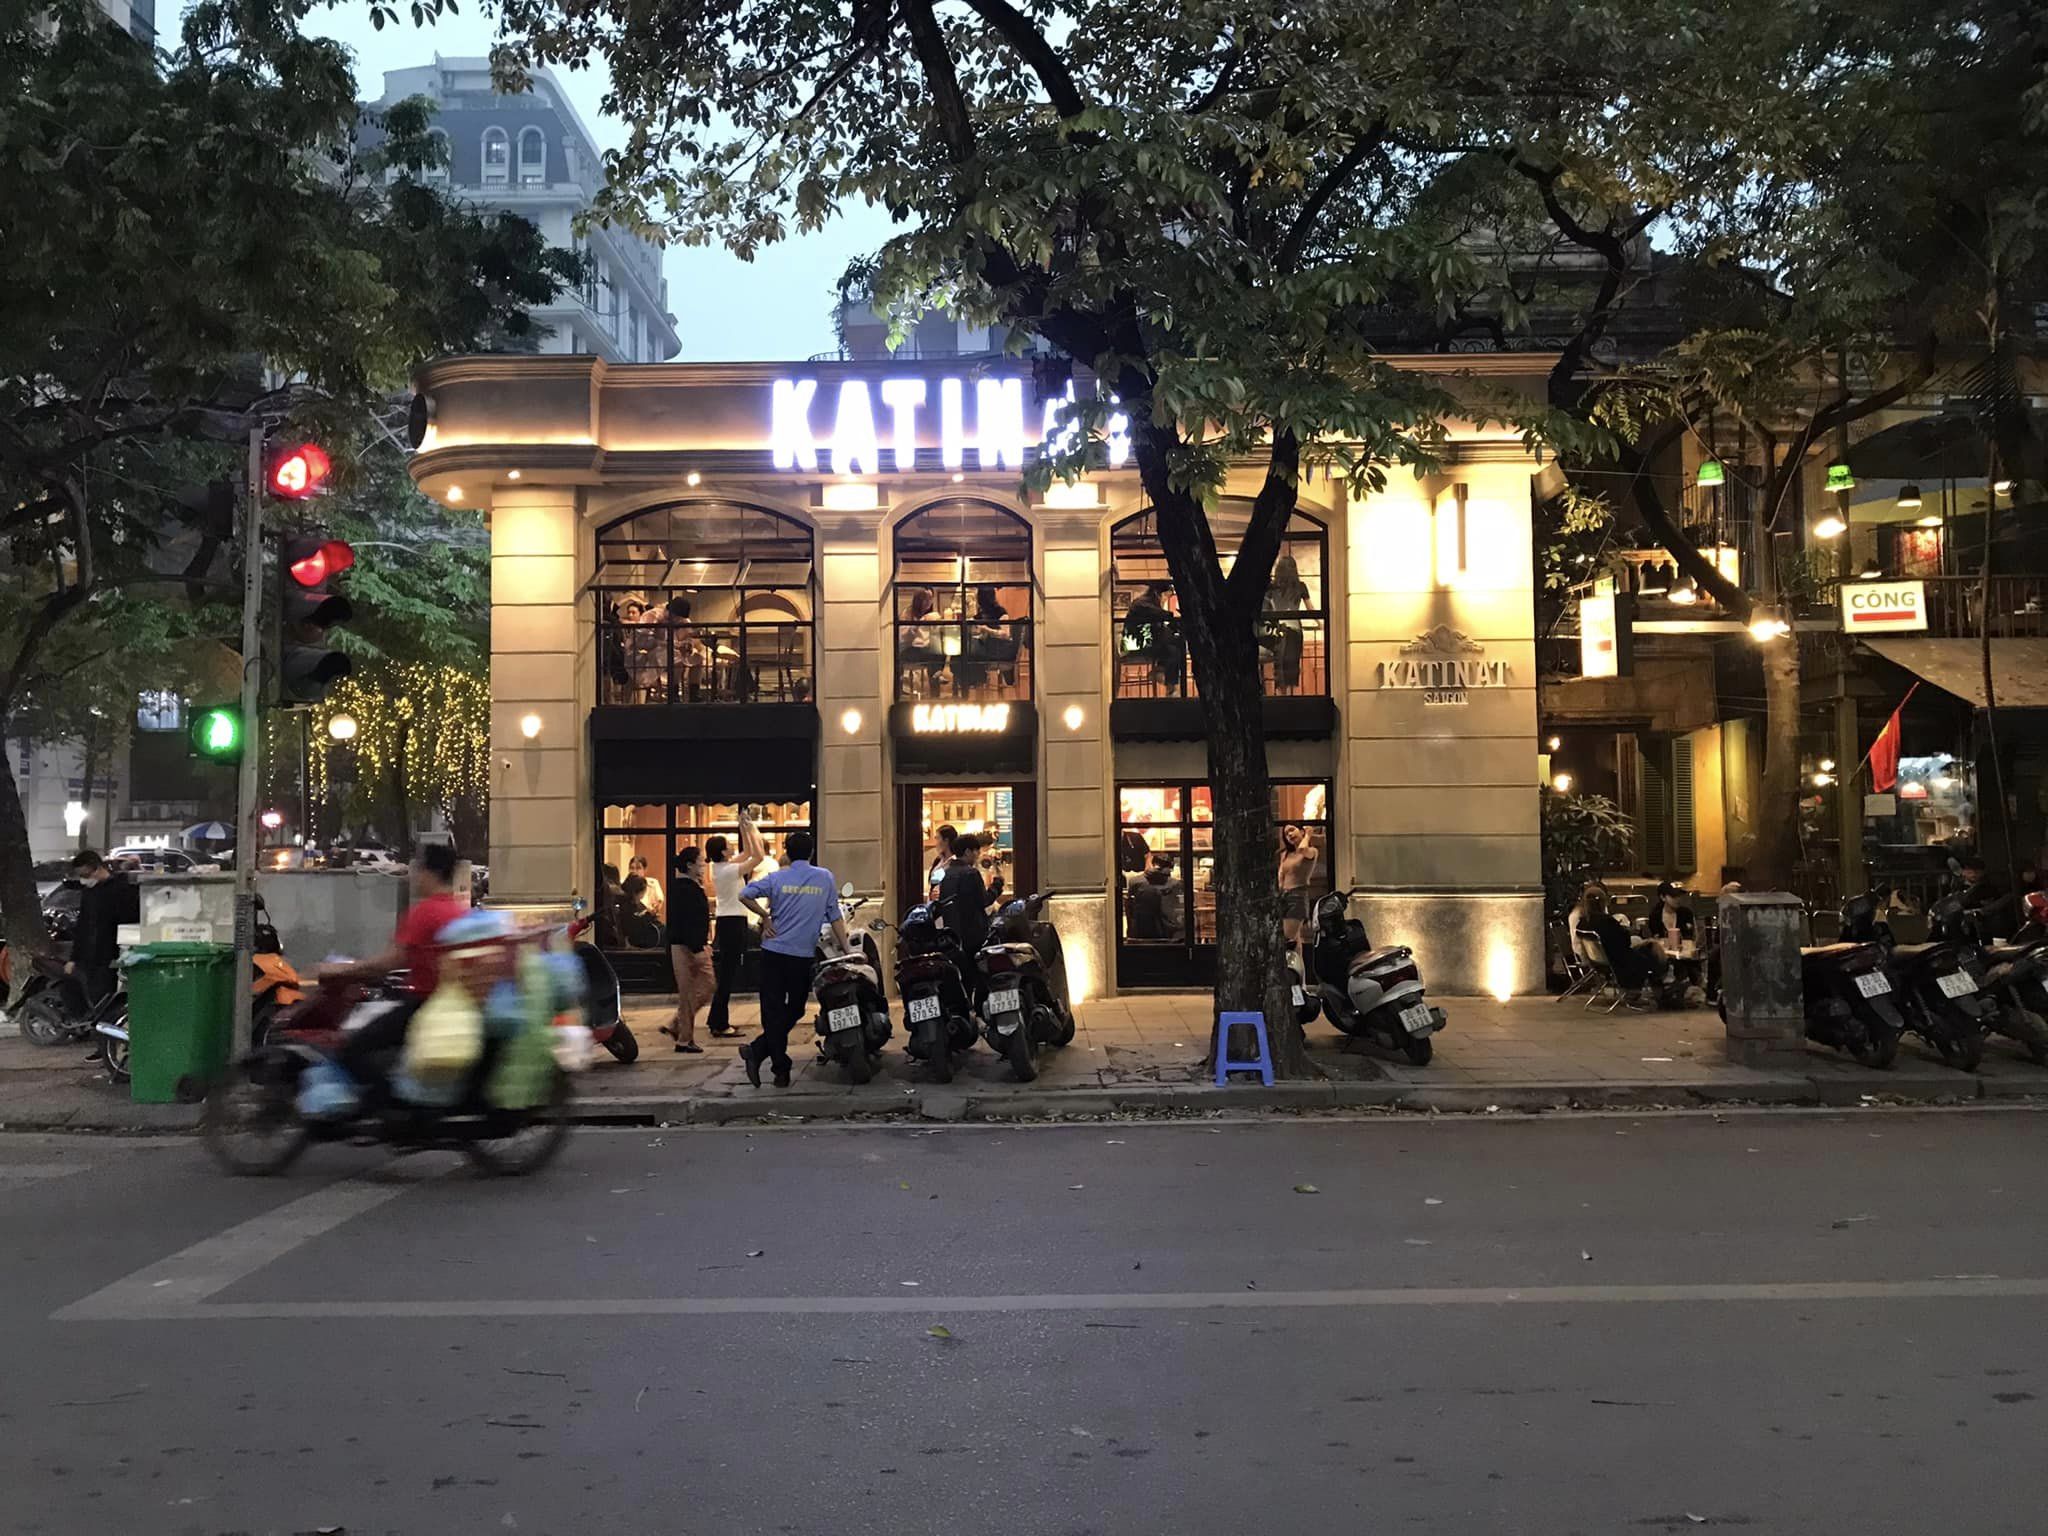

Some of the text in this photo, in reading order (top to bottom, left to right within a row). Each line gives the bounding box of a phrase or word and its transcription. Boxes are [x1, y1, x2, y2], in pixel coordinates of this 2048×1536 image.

[1851, 590, 1916, 609] CÔNG
[1378, 660, 1510, 689] KATINAT
[1424, 692, 1469, 706] SAIGON
